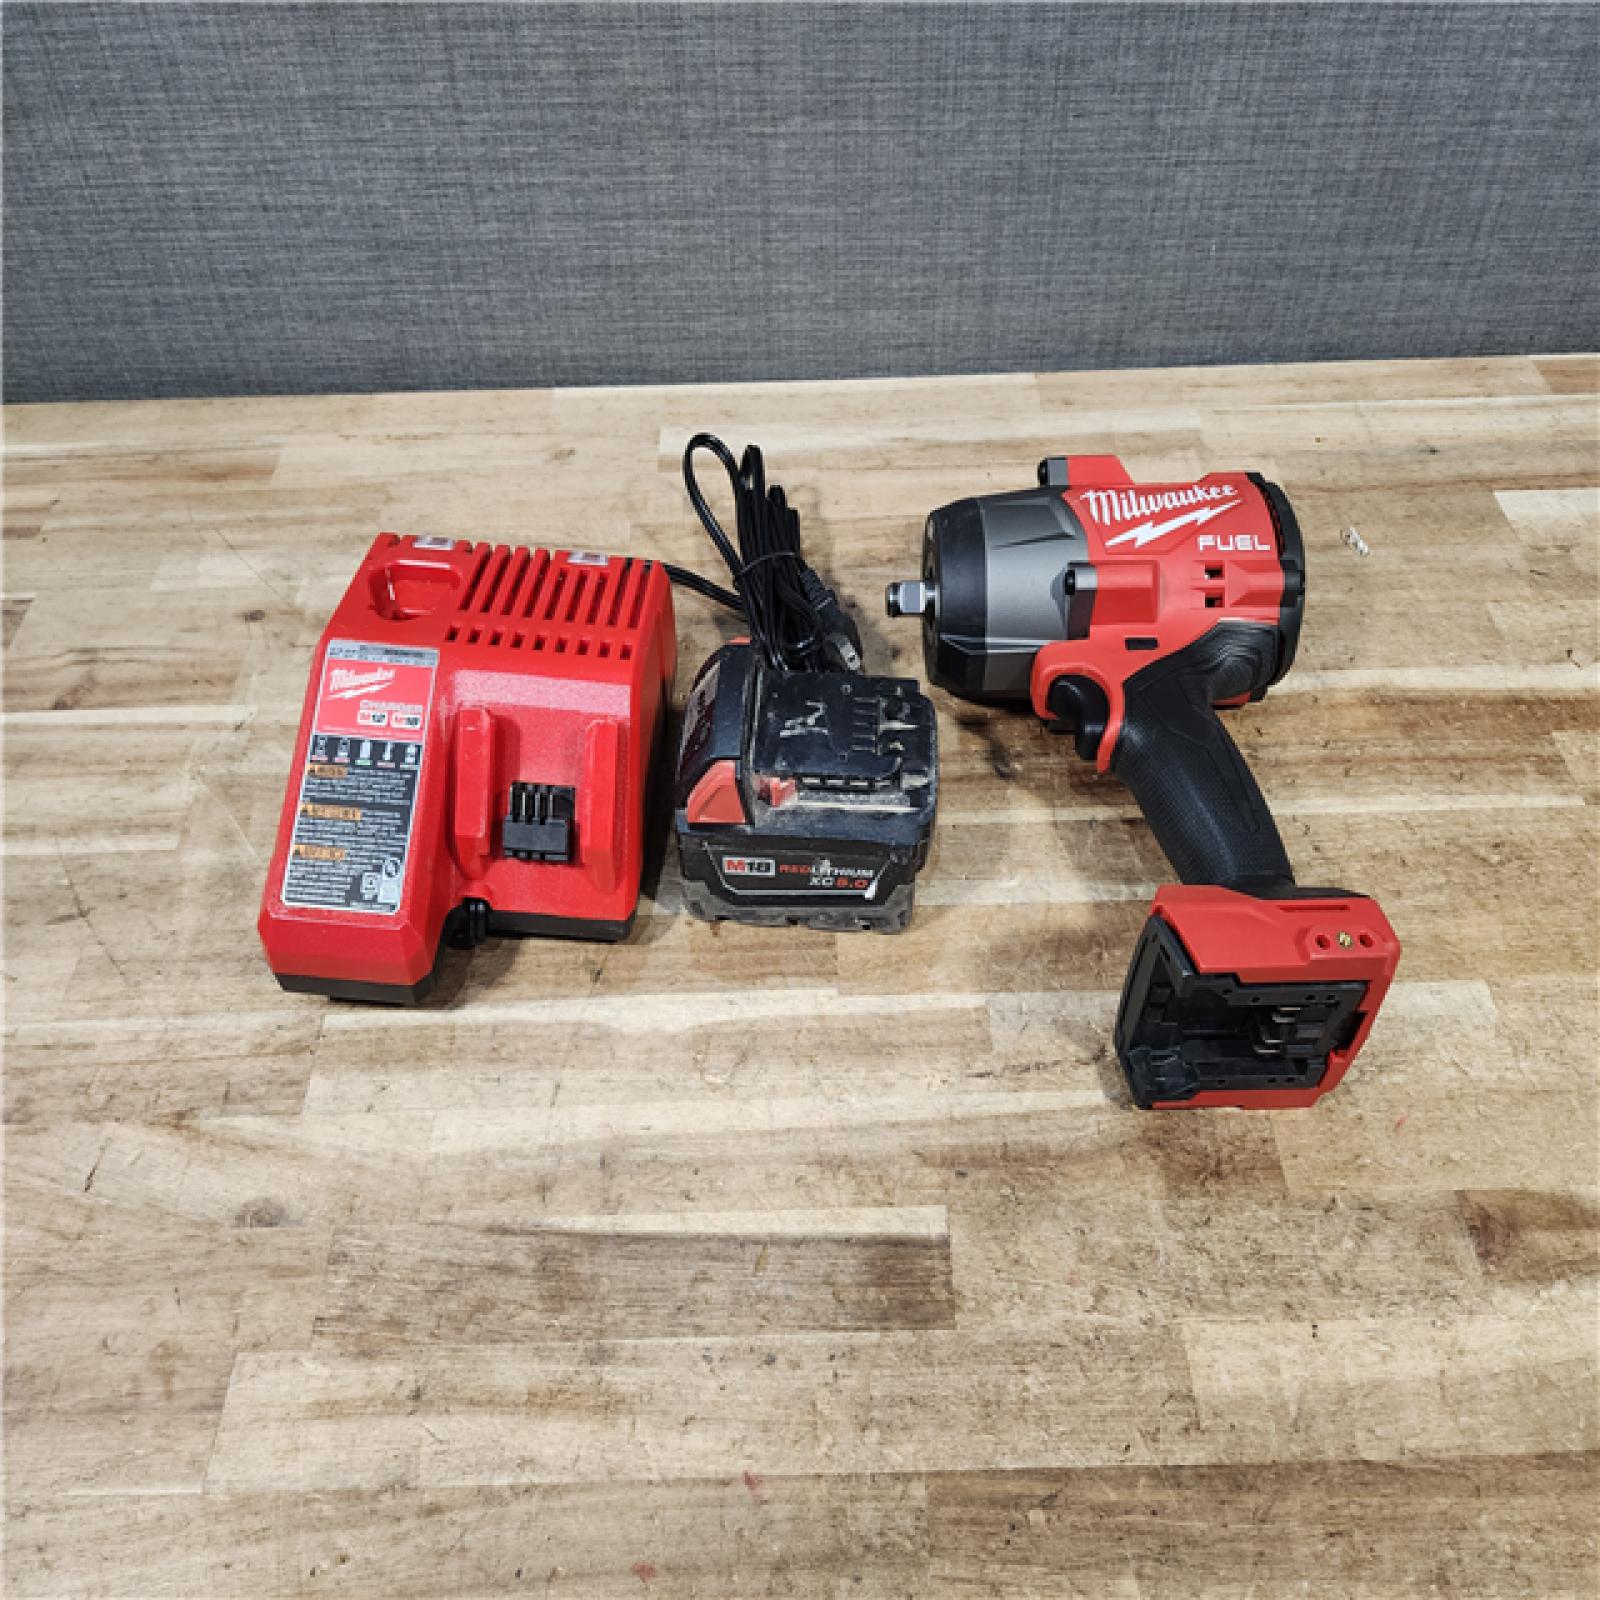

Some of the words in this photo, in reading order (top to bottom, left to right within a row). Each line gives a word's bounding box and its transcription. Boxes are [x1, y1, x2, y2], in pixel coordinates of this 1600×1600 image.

[1080, 484, 1238, 525] Milwaukee
[1197, 534, 1271, 551] FUEL
[724, 858, 773, 874] M18
